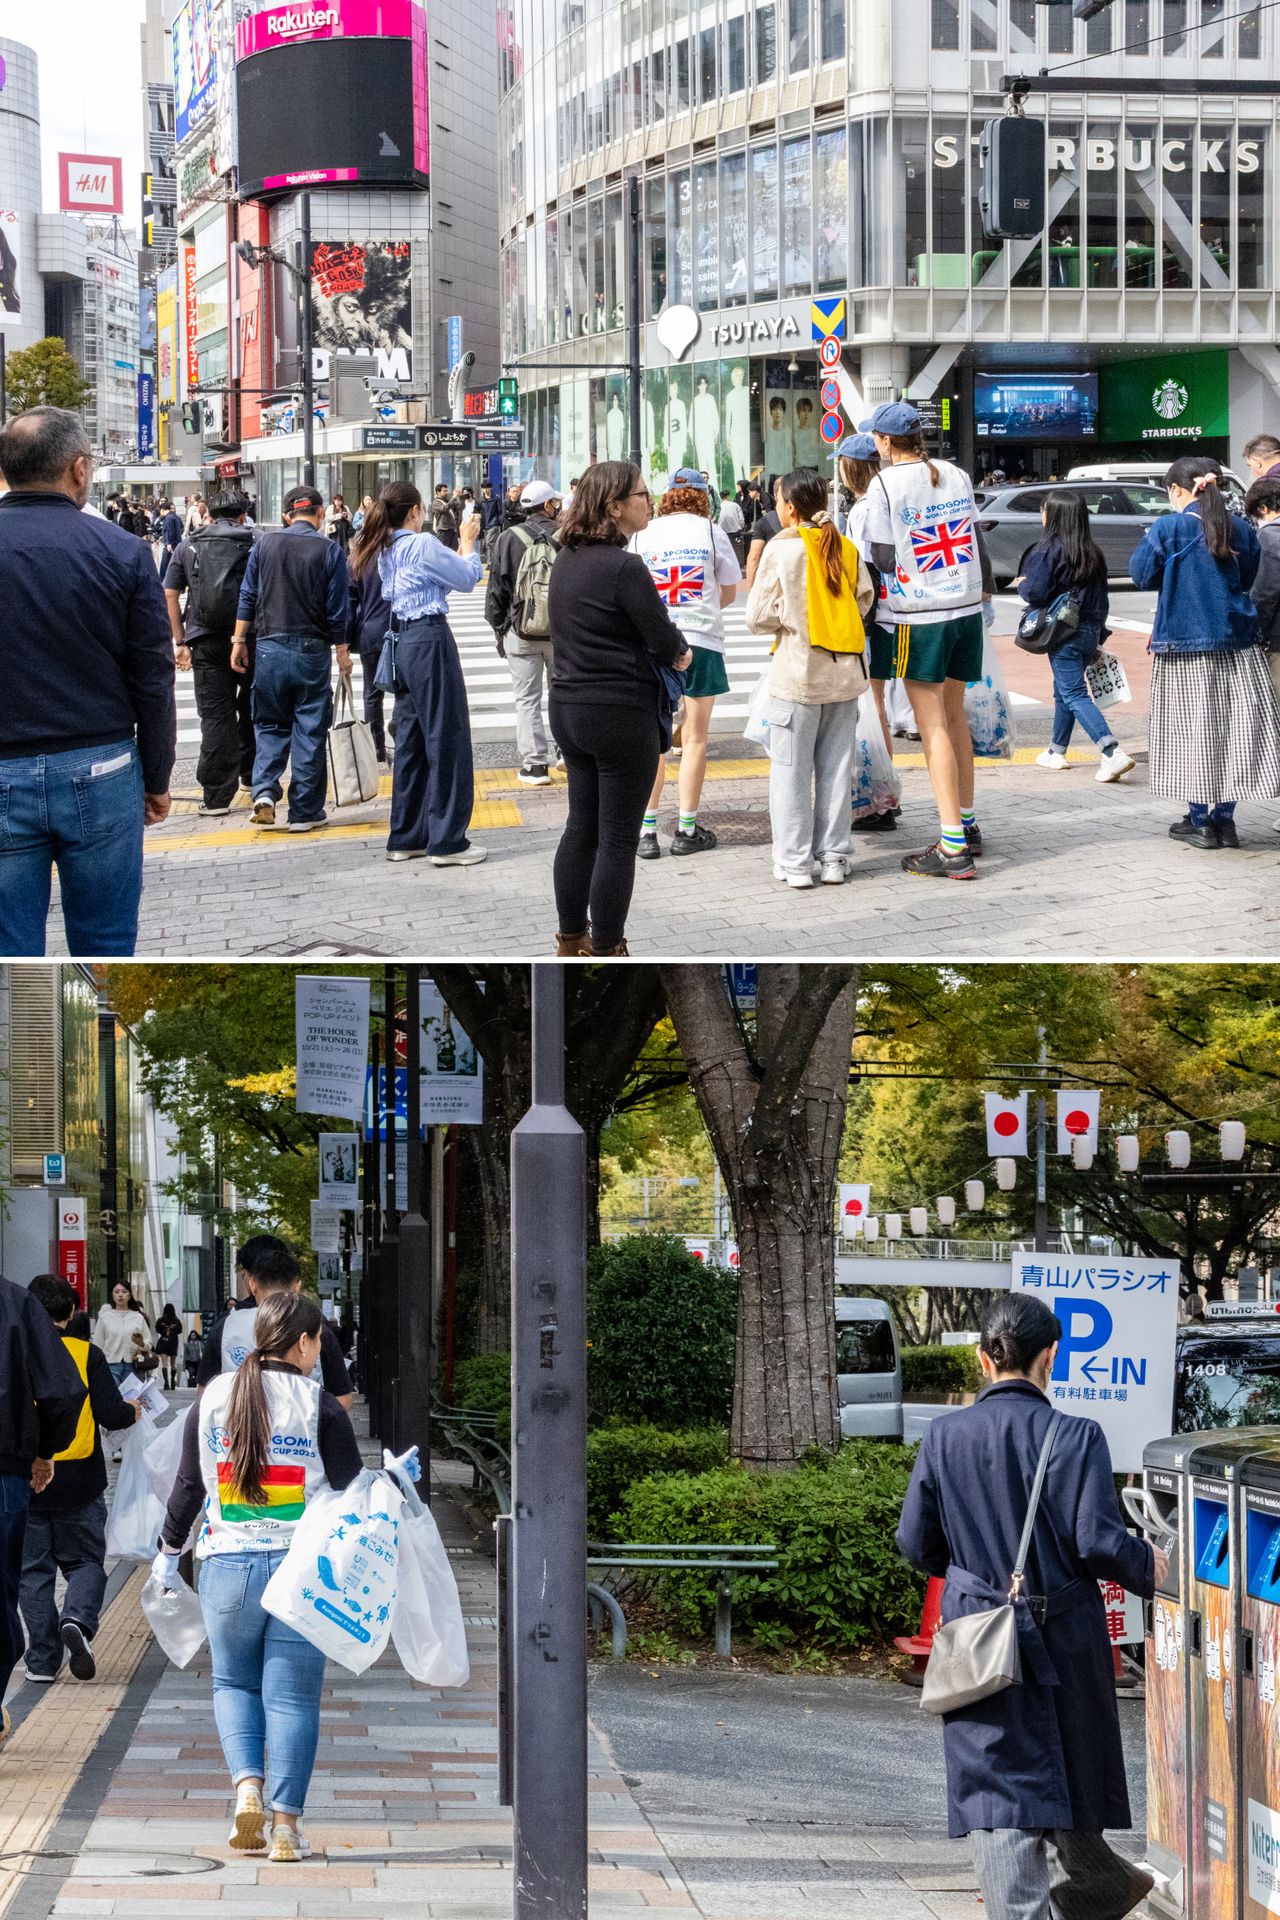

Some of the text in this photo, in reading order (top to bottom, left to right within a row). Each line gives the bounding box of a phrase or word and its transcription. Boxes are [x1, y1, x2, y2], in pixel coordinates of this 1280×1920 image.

[268, 9, 339, 36] Rakuten
[934, 136, 1260, 174] SRBUCKS
[76, 173, 107, 193] H&M
[286, 172, 327, 184] Rakuten Vision
[708, 315, 798, 344] TSUTAYA
[312, 347, 411, 380] DM
[1142, 425, 1202, 438] STARBUCKS
[926, 498, 971, 513] SPOGOMI
[663, 548, 709, 557] SPOGOMI
[948, 568, 960, 578] UK
[308, 1026, 358, 1037] THE HOUSE
[306, 1034, 359, 1046] OF WONDER
[1020, 1264, 1172, 1294] 青山パラシオ
[1051, 1297, 1114, 1382] P
[1111, 1357, 1147, 1386] IN
[1185, 1364, 1227, 1377] 1408
[1053, 1386, 1128, 1402] 有料駐車場
[272, 1447, 316, 1458] CUP 2025
